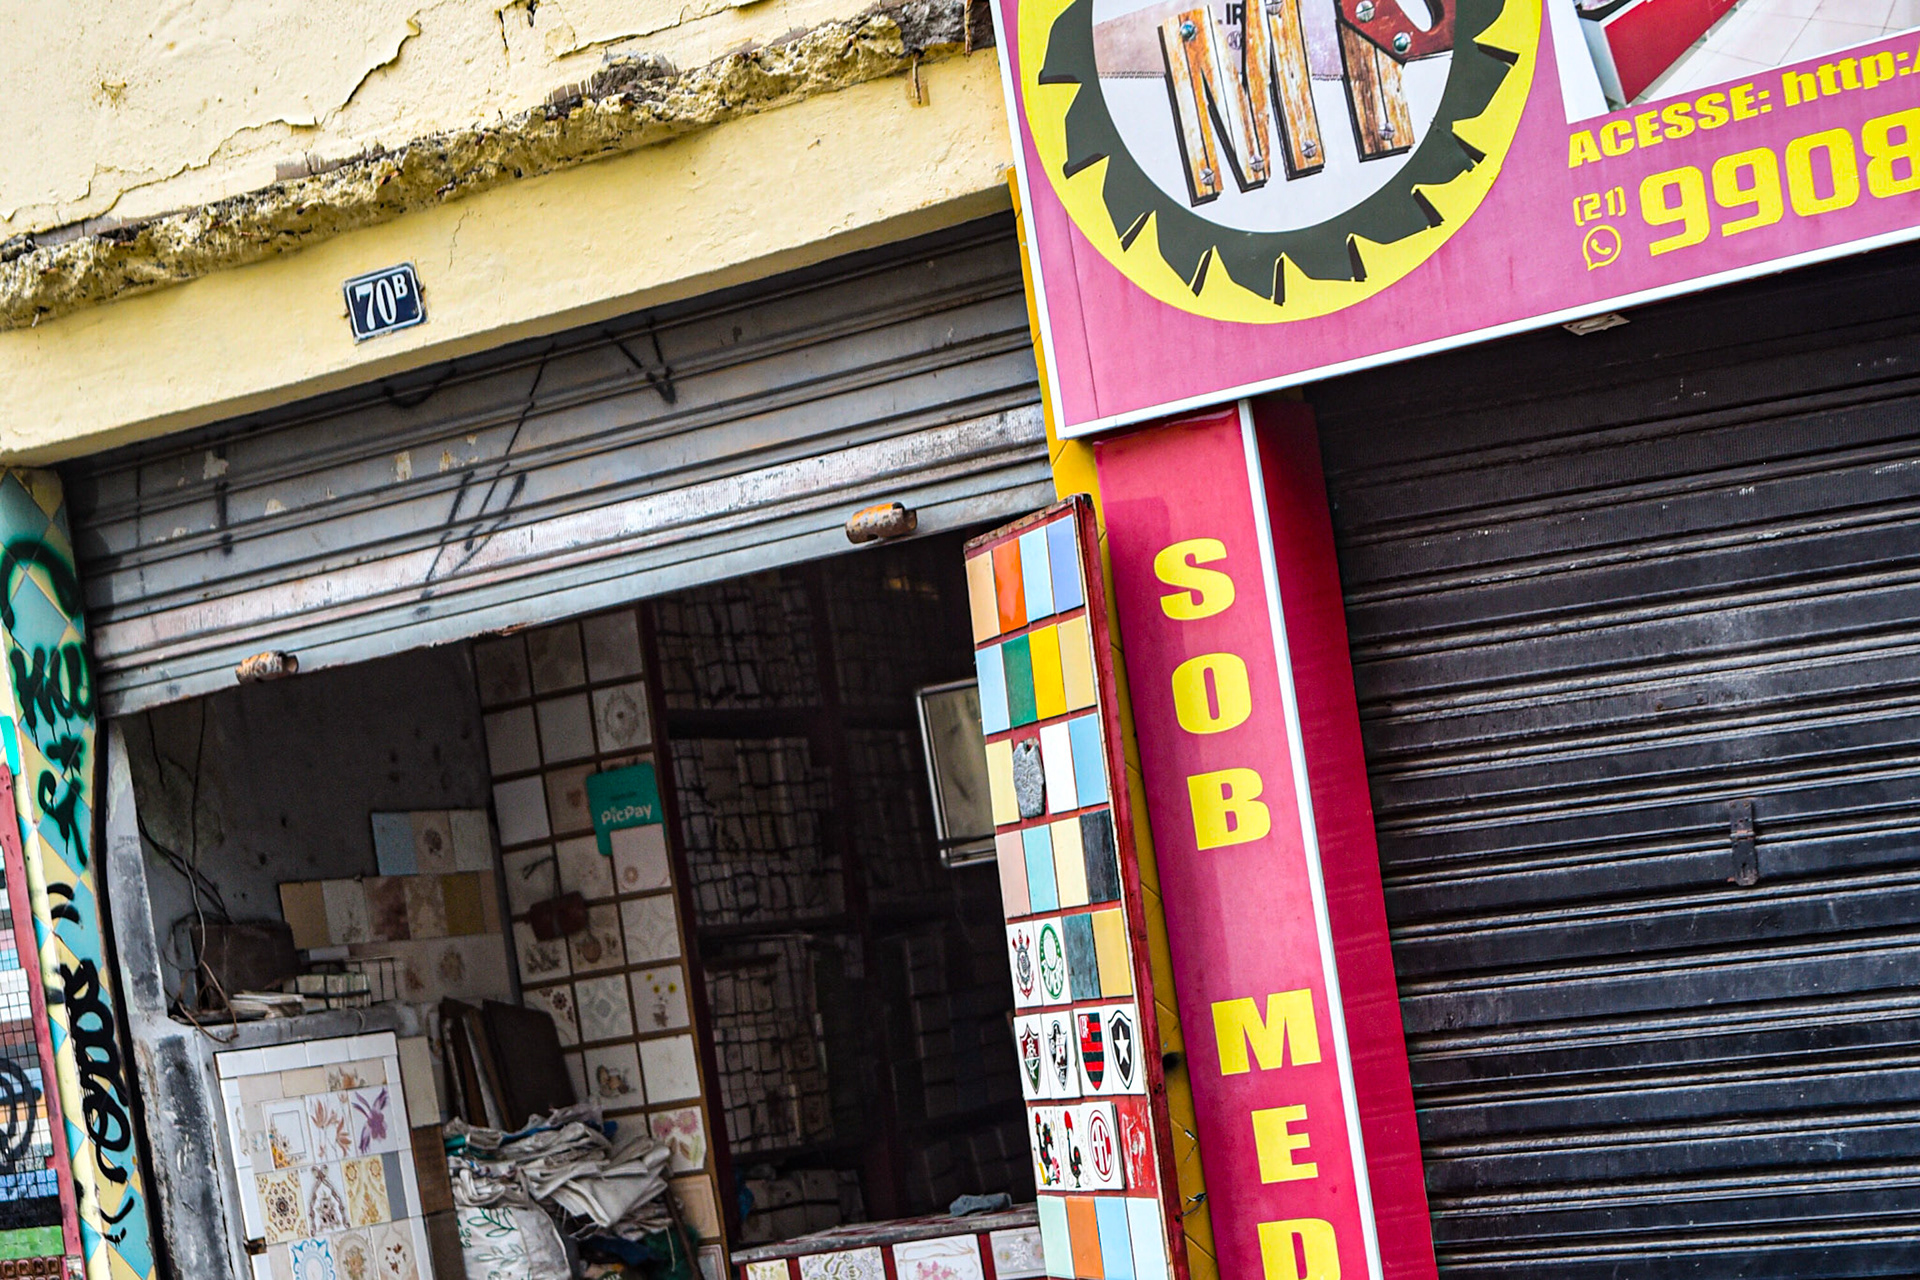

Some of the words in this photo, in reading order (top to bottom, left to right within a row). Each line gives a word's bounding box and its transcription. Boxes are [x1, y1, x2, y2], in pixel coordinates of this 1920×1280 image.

[1568, 82, 1772, 169] ACESSE:
[1573, 186, 1627, 226] (21)
[1639, 107, 1920, 257] 9908
[1153, 537, 1272, 851] SOB
